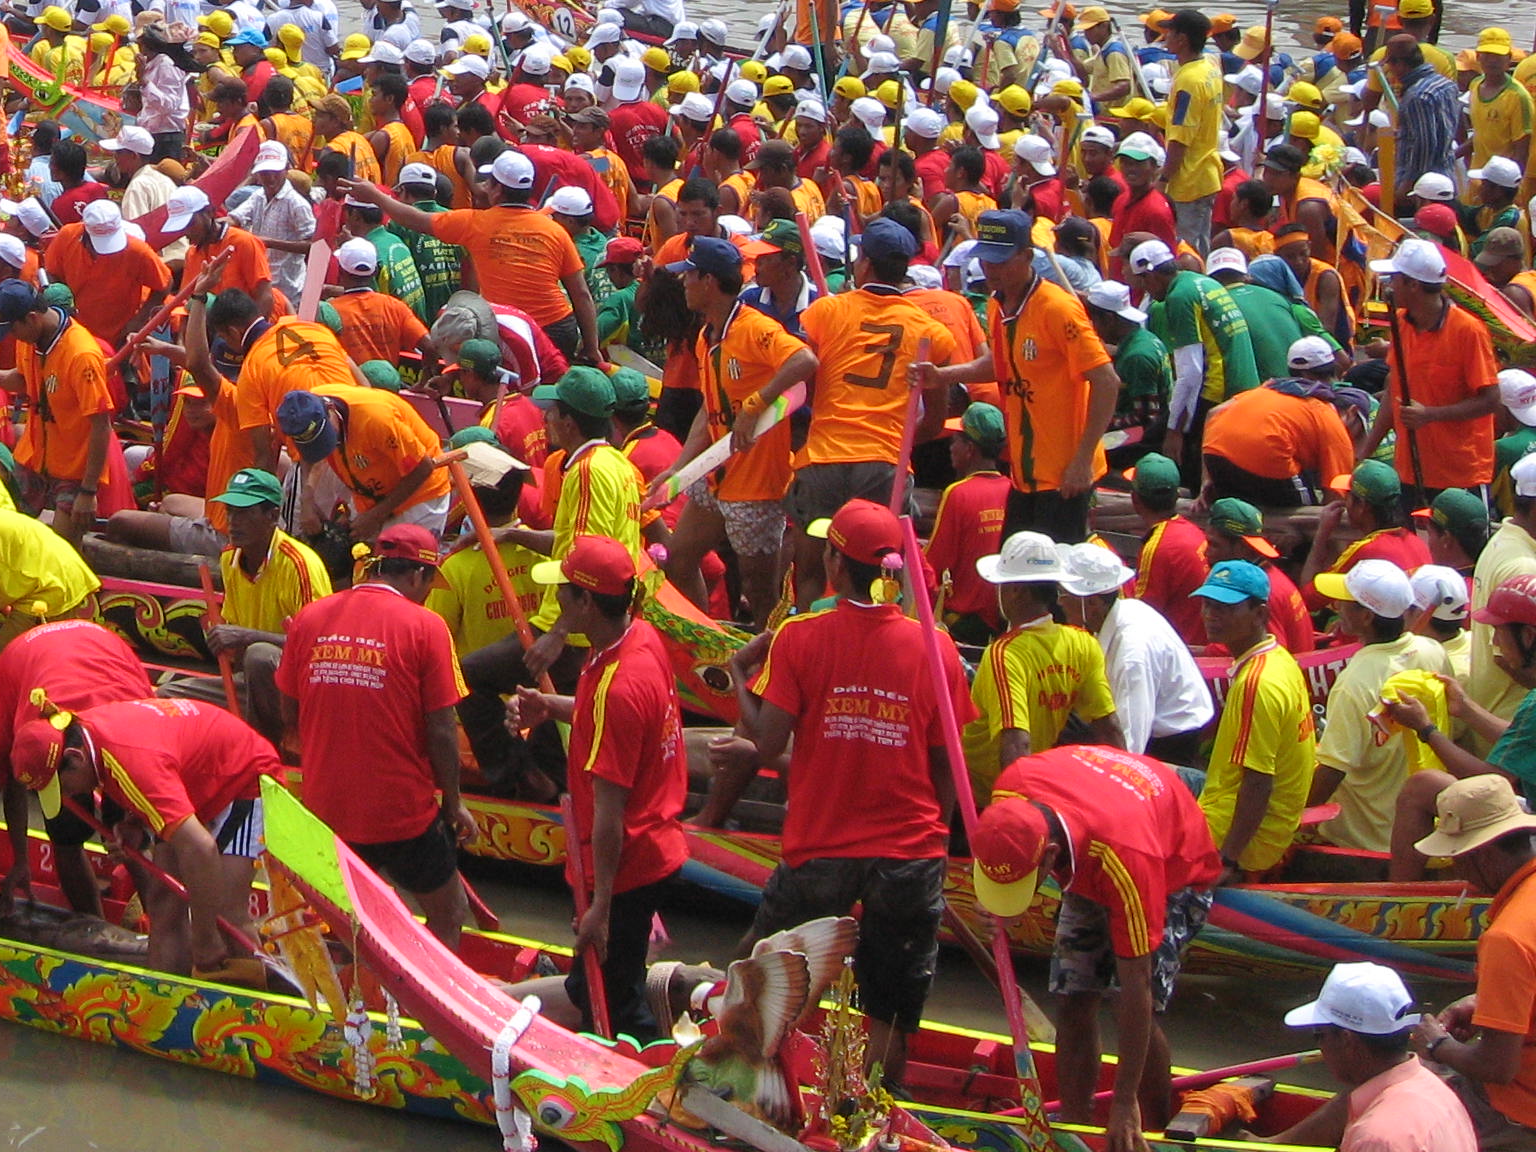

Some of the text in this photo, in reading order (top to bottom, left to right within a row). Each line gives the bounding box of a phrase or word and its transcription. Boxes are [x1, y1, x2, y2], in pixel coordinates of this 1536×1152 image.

[556, 14, 575, 38] 12
[843, 322, 904, 389] 3
[311, 645, 353, 662] XEM
[825, 697, 870, 716] XEM
